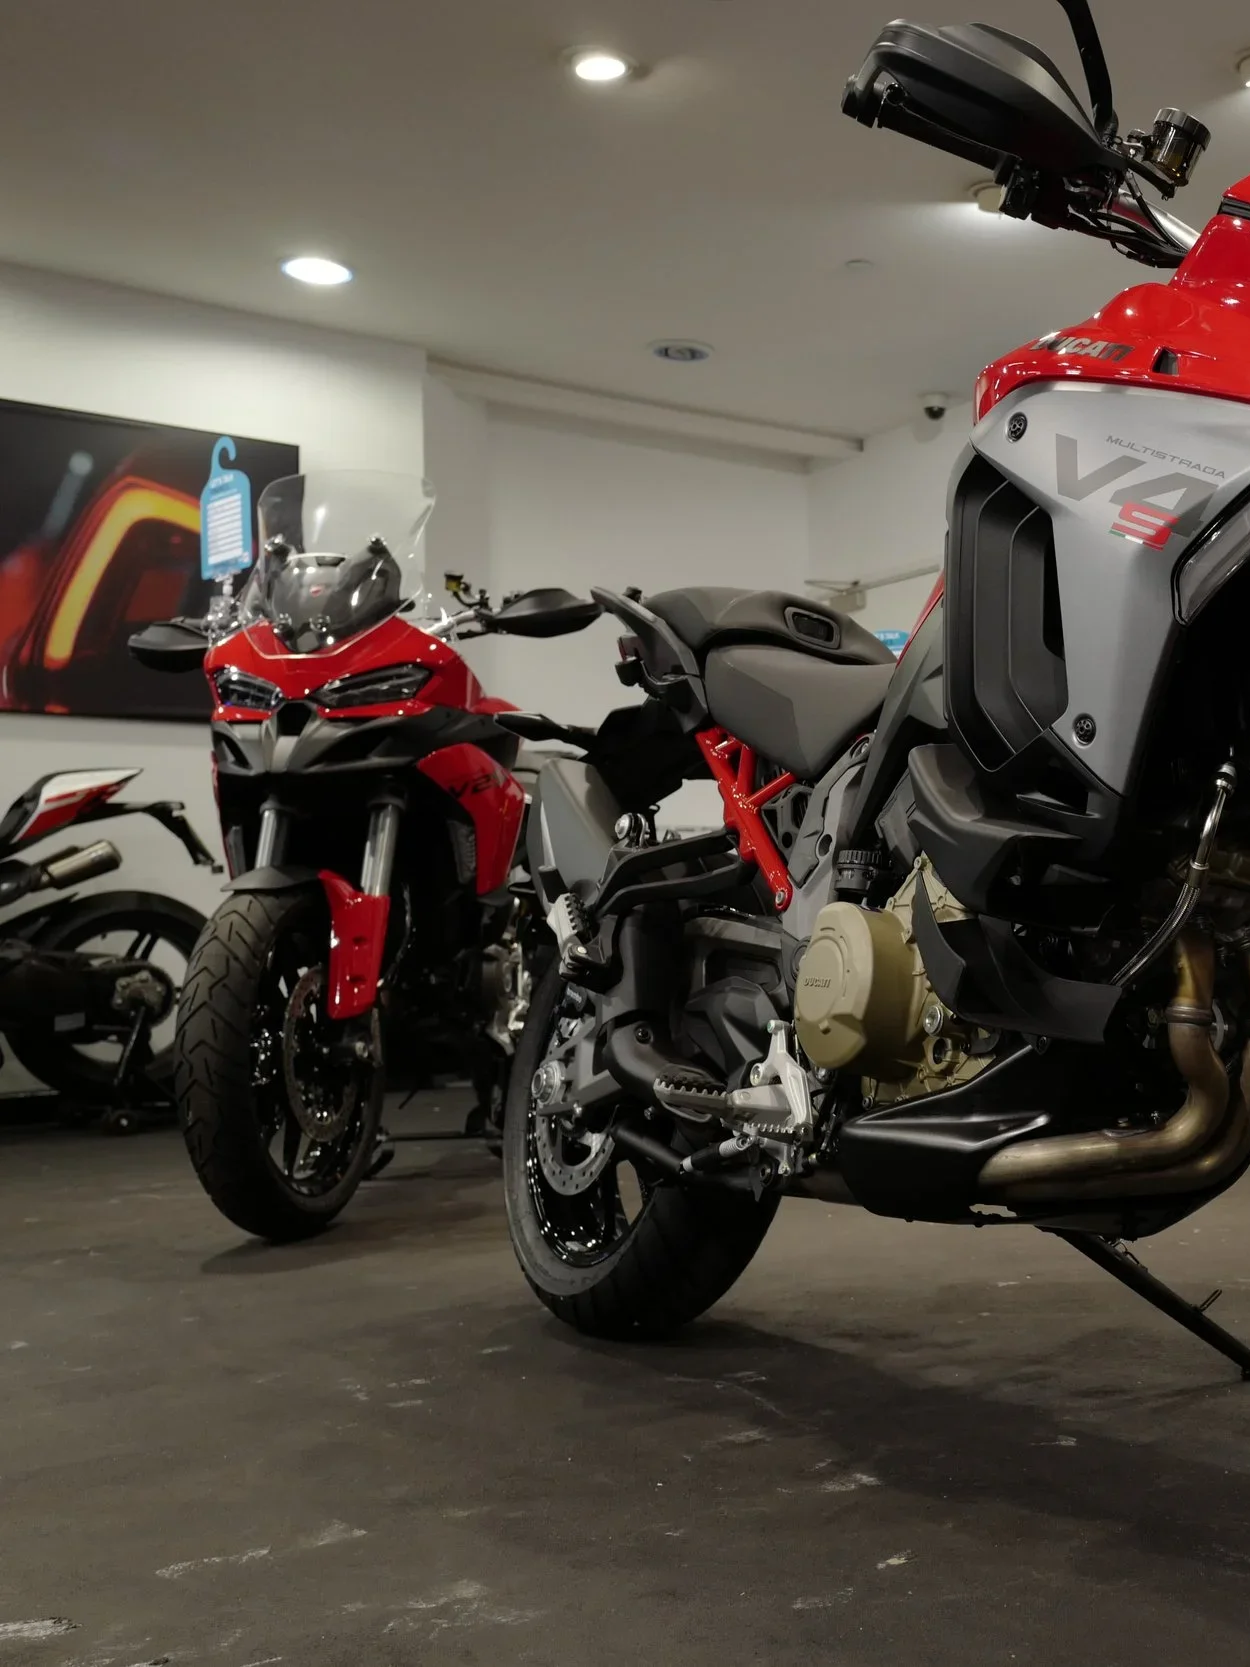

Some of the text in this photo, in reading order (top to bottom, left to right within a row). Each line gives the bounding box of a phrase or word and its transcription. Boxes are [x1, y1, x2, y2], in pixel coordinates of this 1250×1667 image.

[1106, 435, 1226, 479] MULTISTRADA
[1055, 432, 1220, 538] V4
[803, 977, 833, 990] DUCATI
